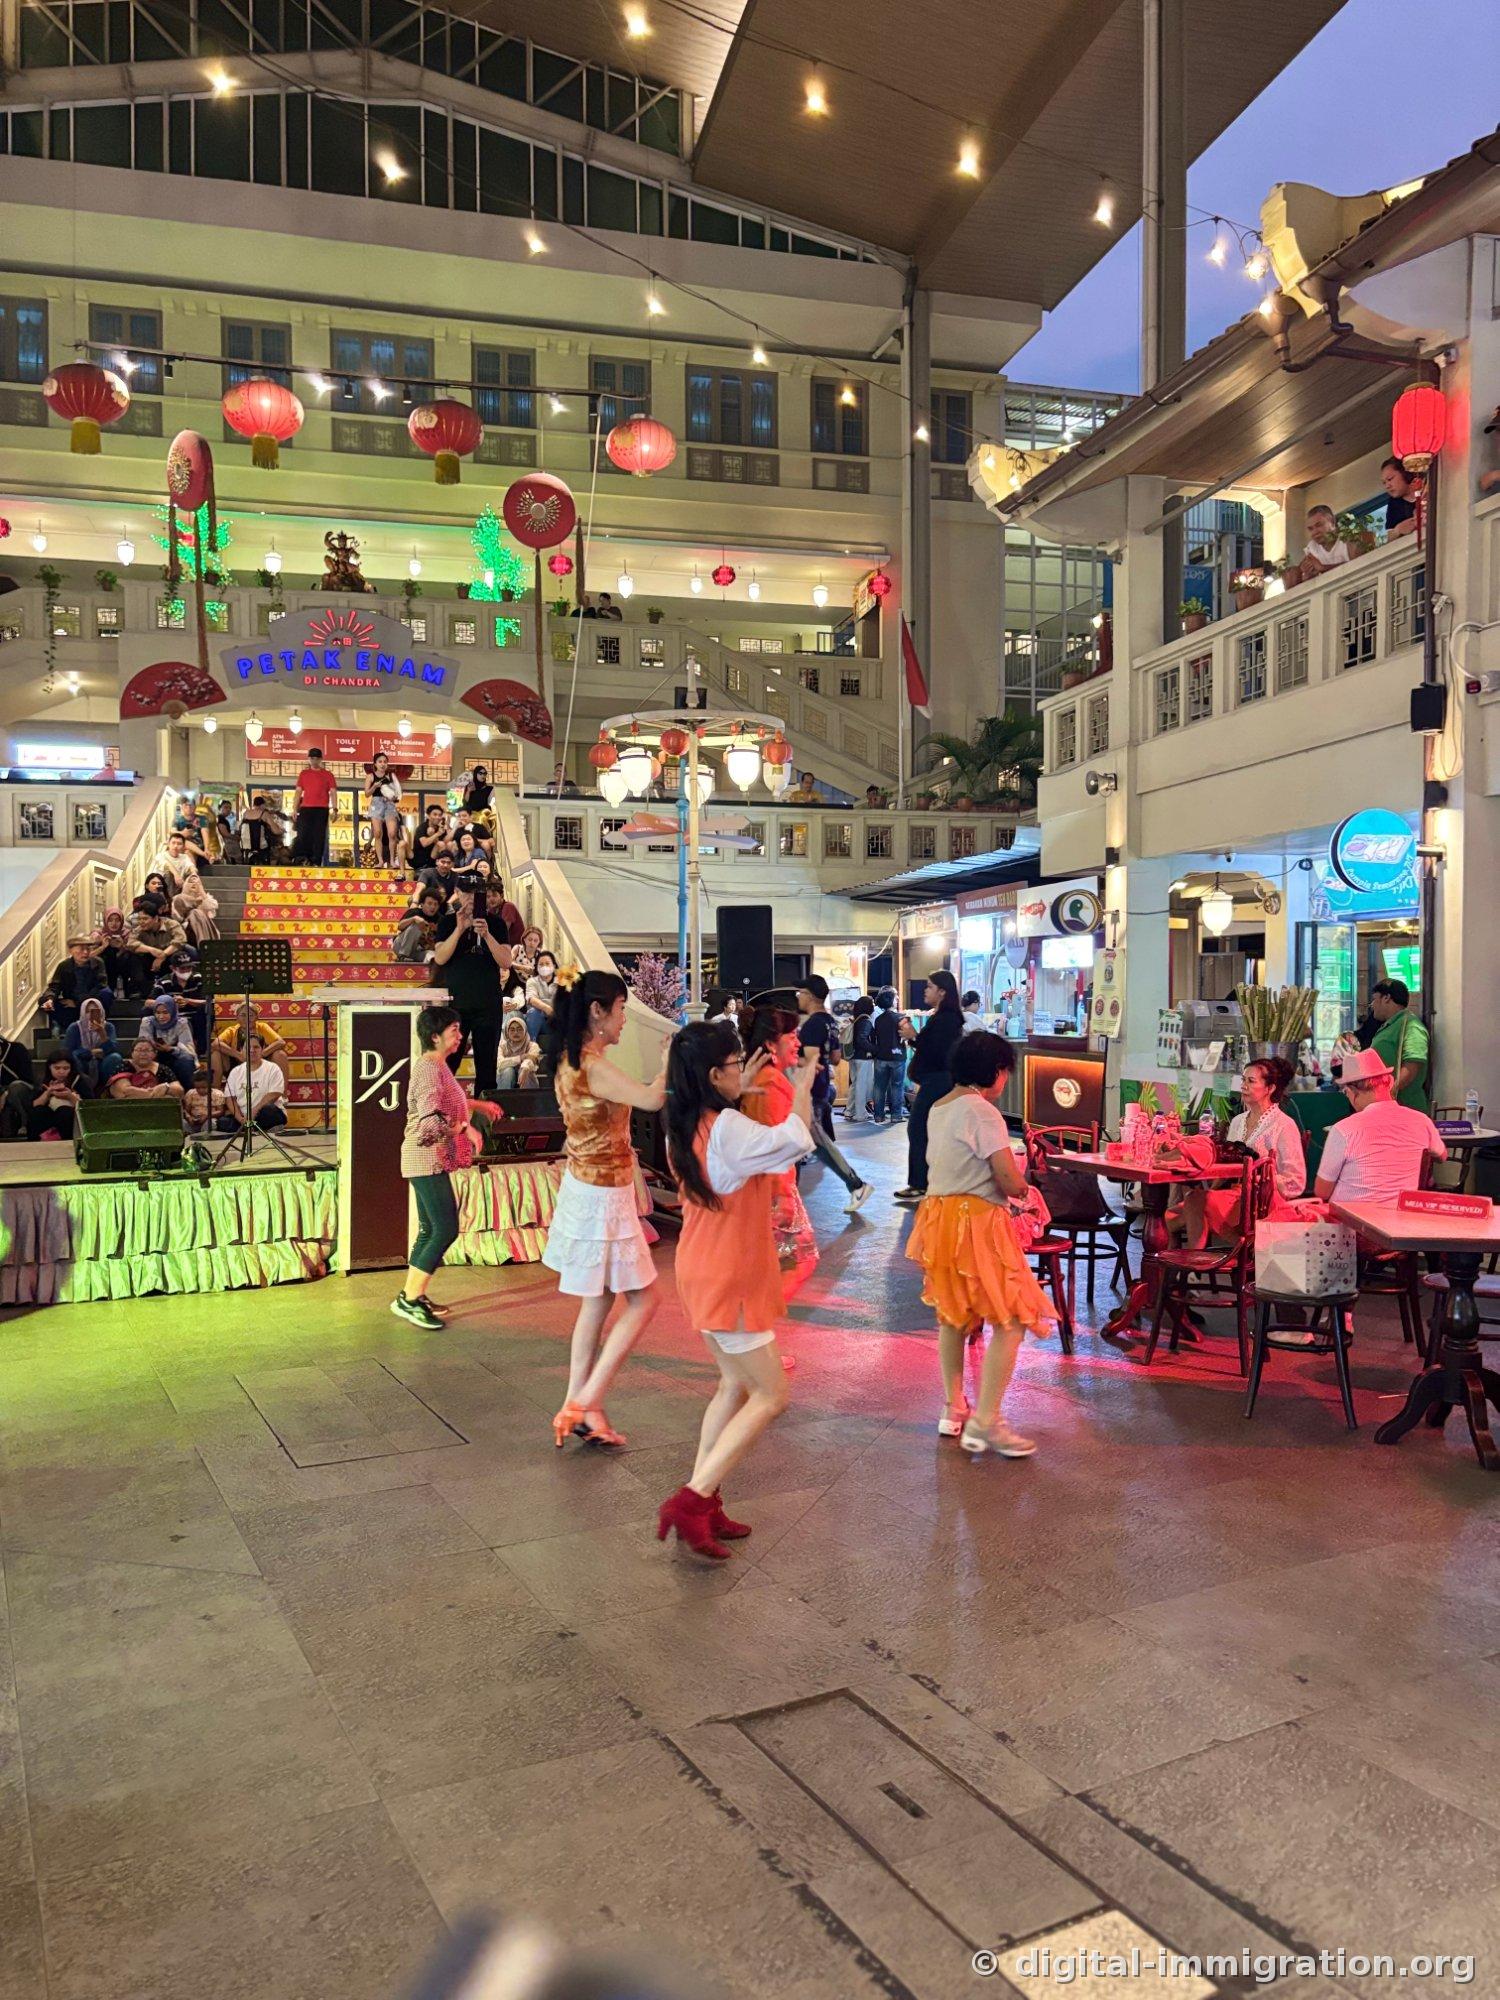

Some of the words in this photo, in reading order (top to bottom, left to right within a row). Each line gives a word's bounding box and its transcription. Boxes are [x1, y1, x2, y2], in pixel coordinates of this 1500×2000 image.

[237, 650, 340, 679] PETAK
[356, 651, 447, 686] ENAM
[304, 676, 317, 685] DI
[323, 677, 380, 687] CHANDRA
[336, 738, 361, 746] TOILET
[1404, 1200, 1424, 1208] MEJA
[1425, 1202, 1438, 1210] VIP
